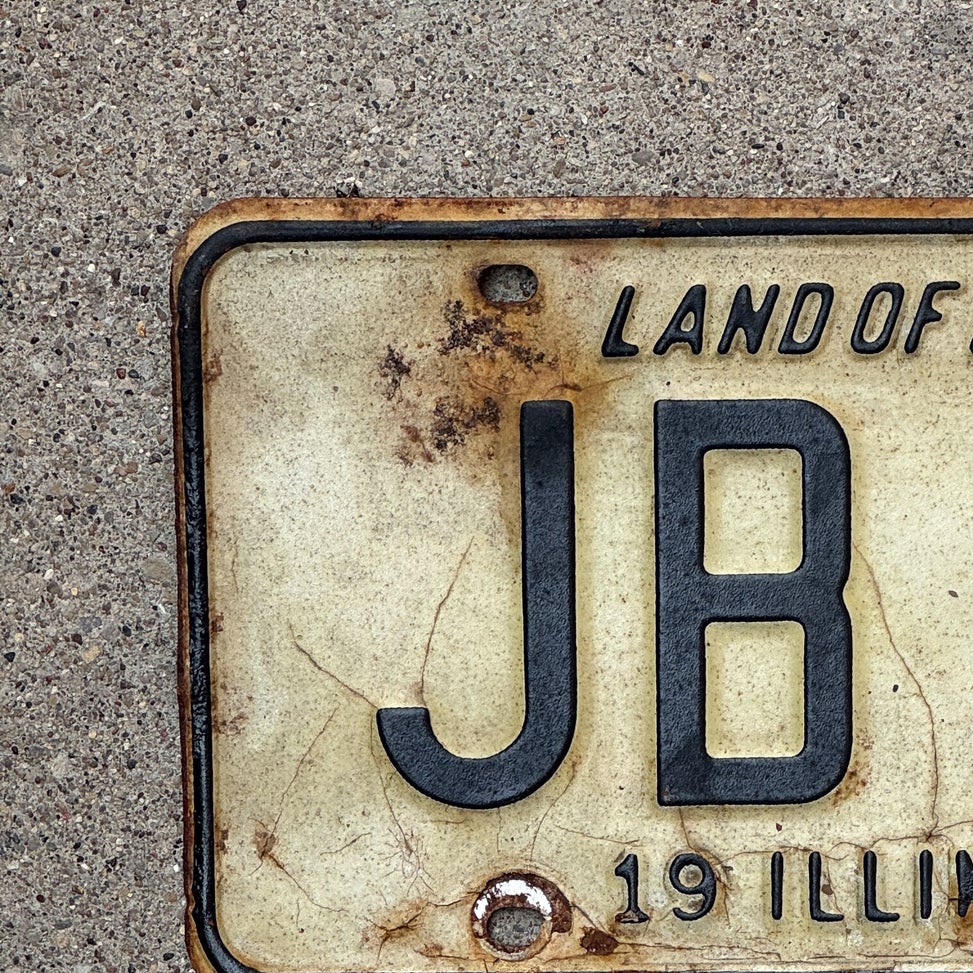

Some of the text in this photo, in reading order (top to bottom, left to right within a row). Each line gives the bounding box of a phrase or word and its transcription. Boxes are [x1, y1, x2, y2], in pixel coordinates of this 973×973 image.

[601, 280, 834, 357] LAND
[850, 279, 961, 356] OF
[376, 399, 852, 809] JB
[613, 852, 717, 925] 19
